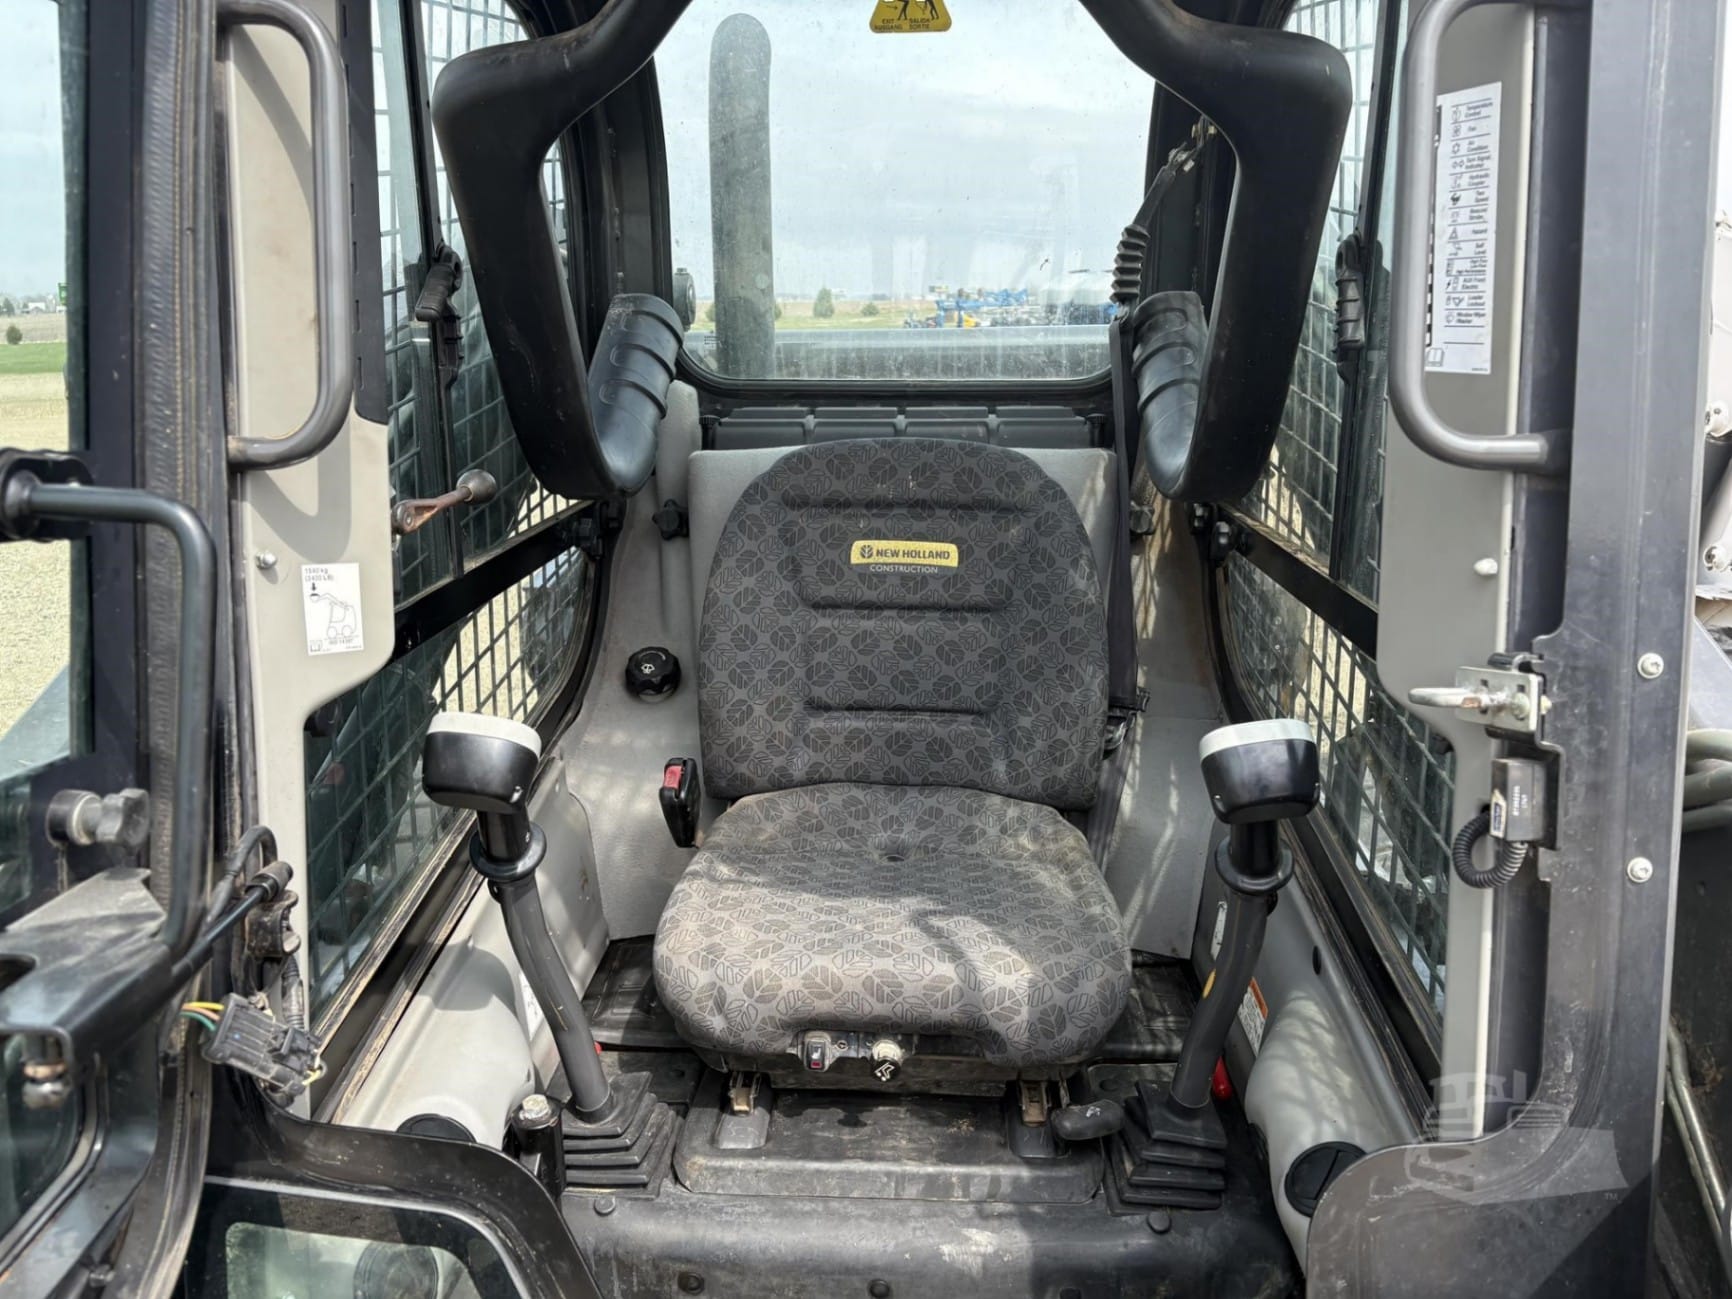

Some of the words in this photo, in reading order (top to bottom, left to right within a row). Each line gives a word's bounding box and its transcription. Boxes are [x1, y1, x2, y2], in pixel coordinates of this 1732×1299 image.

[876, 549, 900, 558] NEW
[902, 550, 950, 560] HOLLAND
[870, 564, 938, 574] CONSTRUCTION
